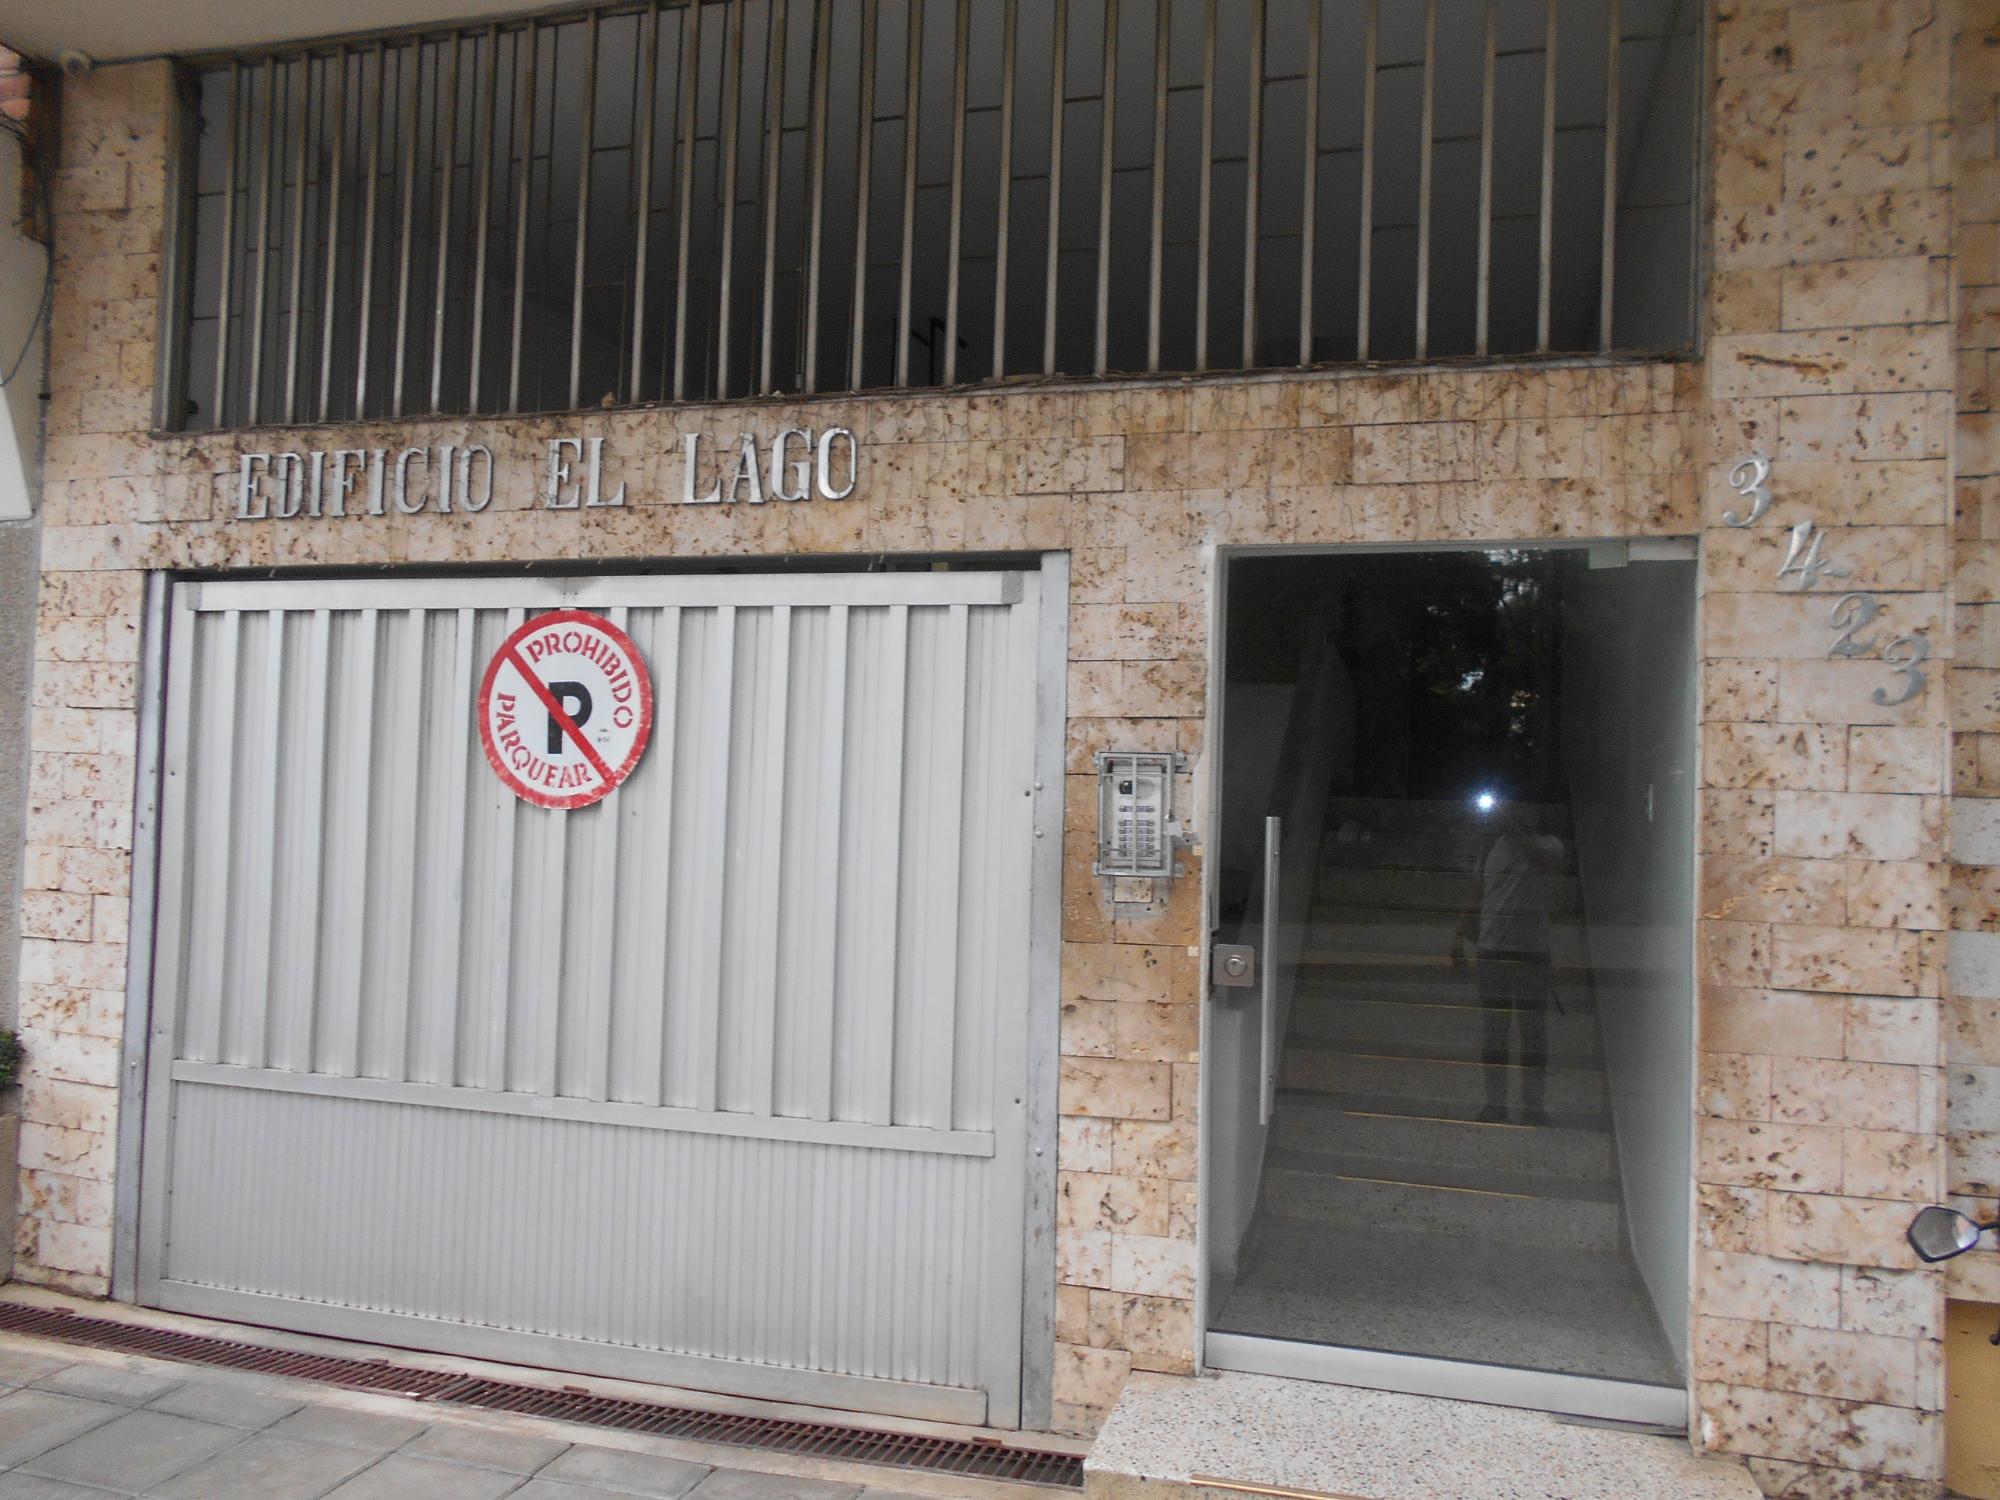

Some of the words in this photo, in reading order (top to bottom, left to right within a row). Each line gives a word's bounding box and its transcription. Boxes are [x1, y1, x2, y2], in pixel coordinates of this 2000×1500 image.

[236, 444, 494, 519] EDIFICIO
[547, 437, 625, 509] EL
[682, 427, 857, 504] LAGO
[525, 631, 633, 729] PROHIBIDO
[547, 681, 593, 755] P
[496, 693, 592, 788] PARQUEAR
